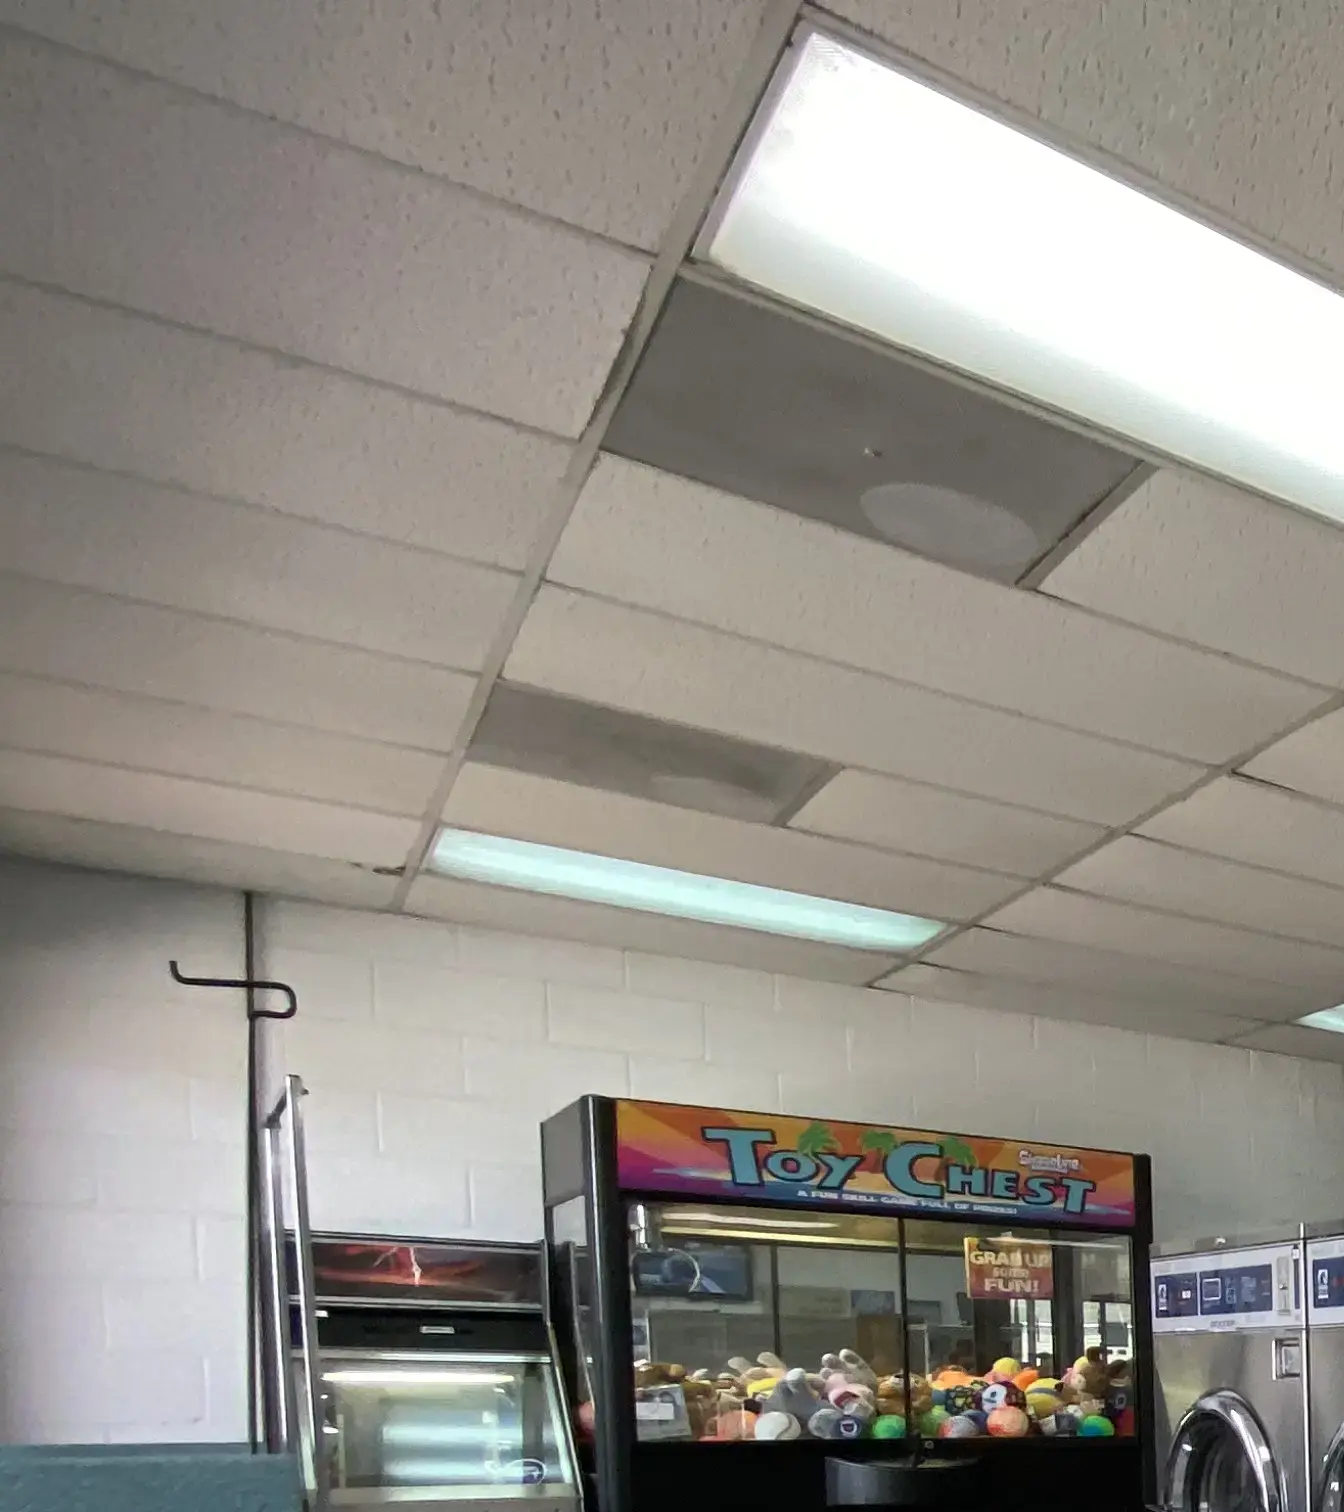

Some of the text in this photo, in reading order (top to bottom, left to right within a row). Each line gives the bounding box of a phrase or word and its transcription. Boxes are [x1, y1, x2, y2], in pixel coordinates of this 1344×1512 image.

[702, 1126, 1097, 1214] TOY CHEST
[984, 1278, 1039, 1292] FUN!
